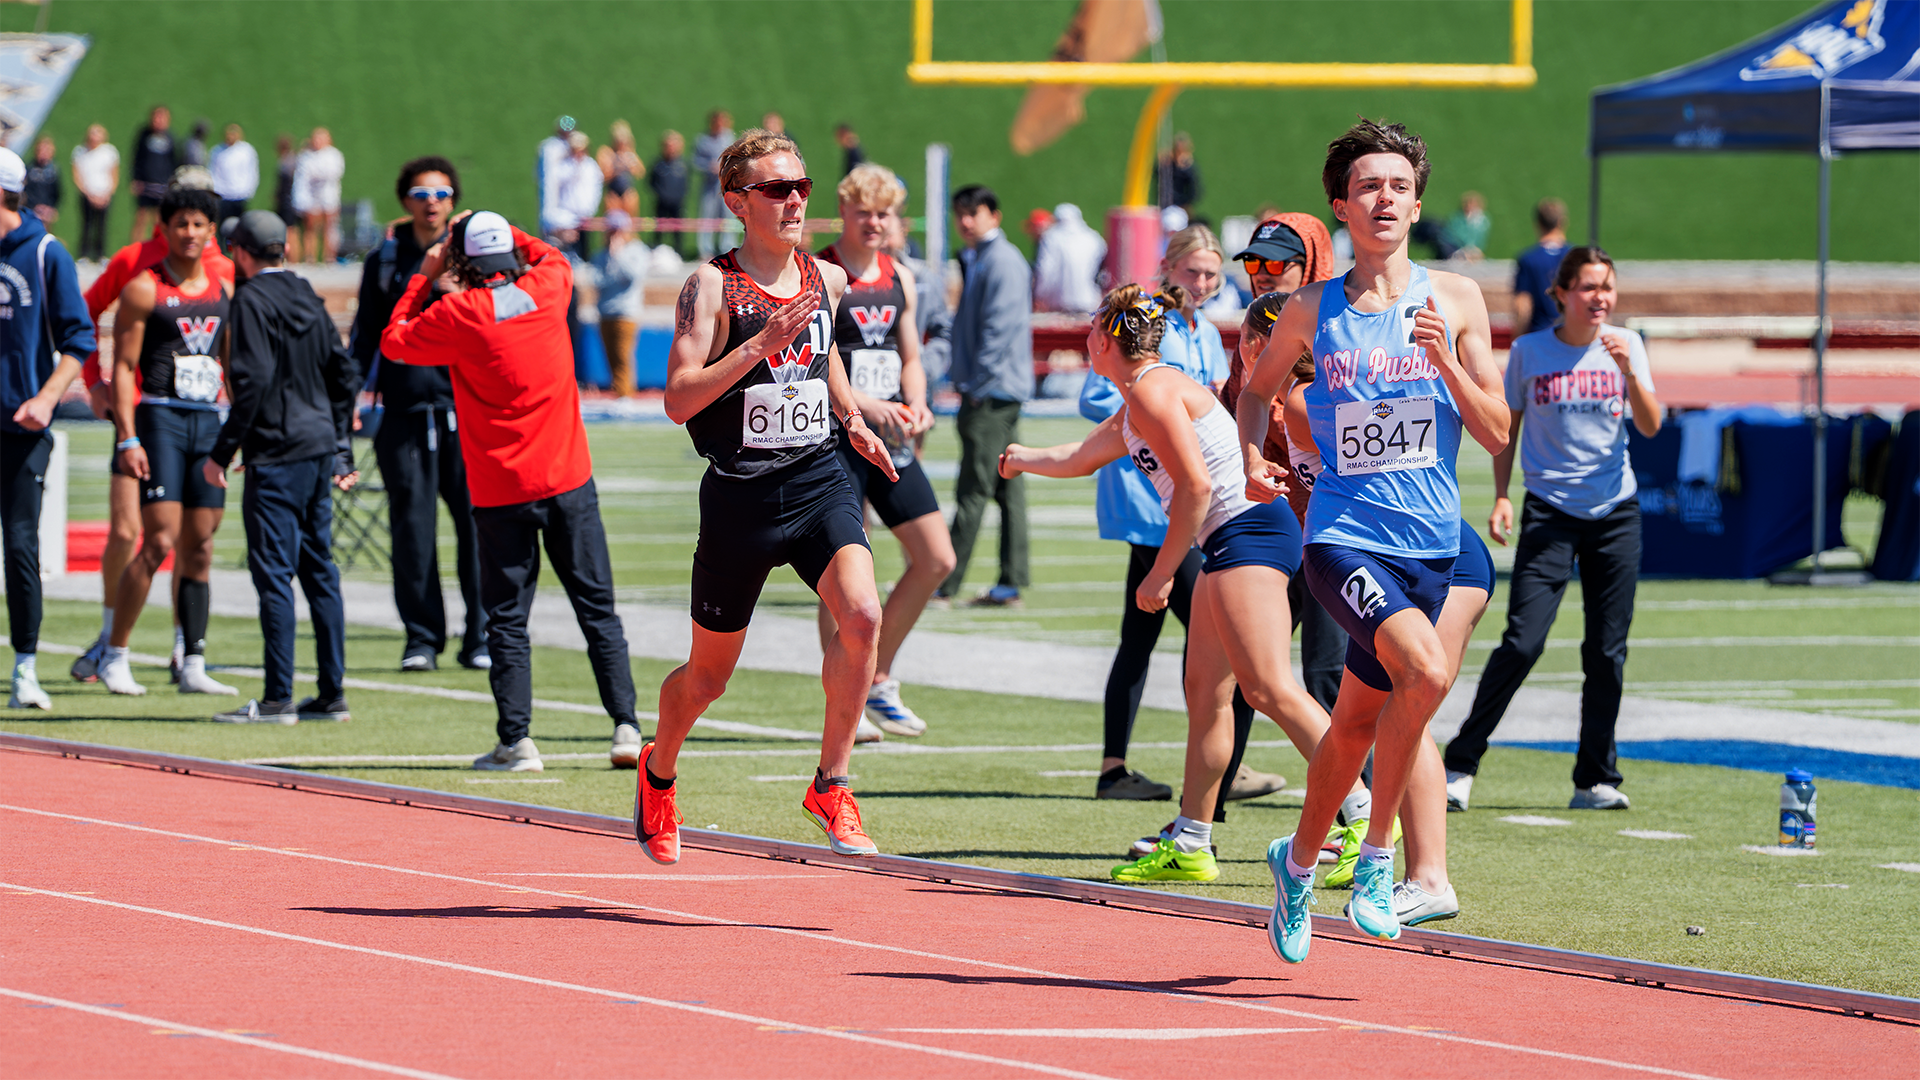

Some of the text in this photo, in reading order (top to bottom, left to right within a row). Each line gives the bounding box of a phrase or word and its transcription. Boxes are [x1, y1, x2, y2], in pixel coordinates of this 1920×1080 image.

[176, 316, 222, 355] W
[849, 305, 897, 347] W
[1323, 348, 1361, 393] CSU
[748, 399, 826, 434] 6164
[1373, 407, 1393, 415] RMAC
[1558, 403, 1602, 413] PACK
[752, 432, 823, 444] RMAC CHAMPIONSHIP
[1341, 418, 1433, 460] 5847
[1346, 456, 1429, 470] RMAC CHAMPIONSHIP
[1346, 574, 1378, 613] 2
